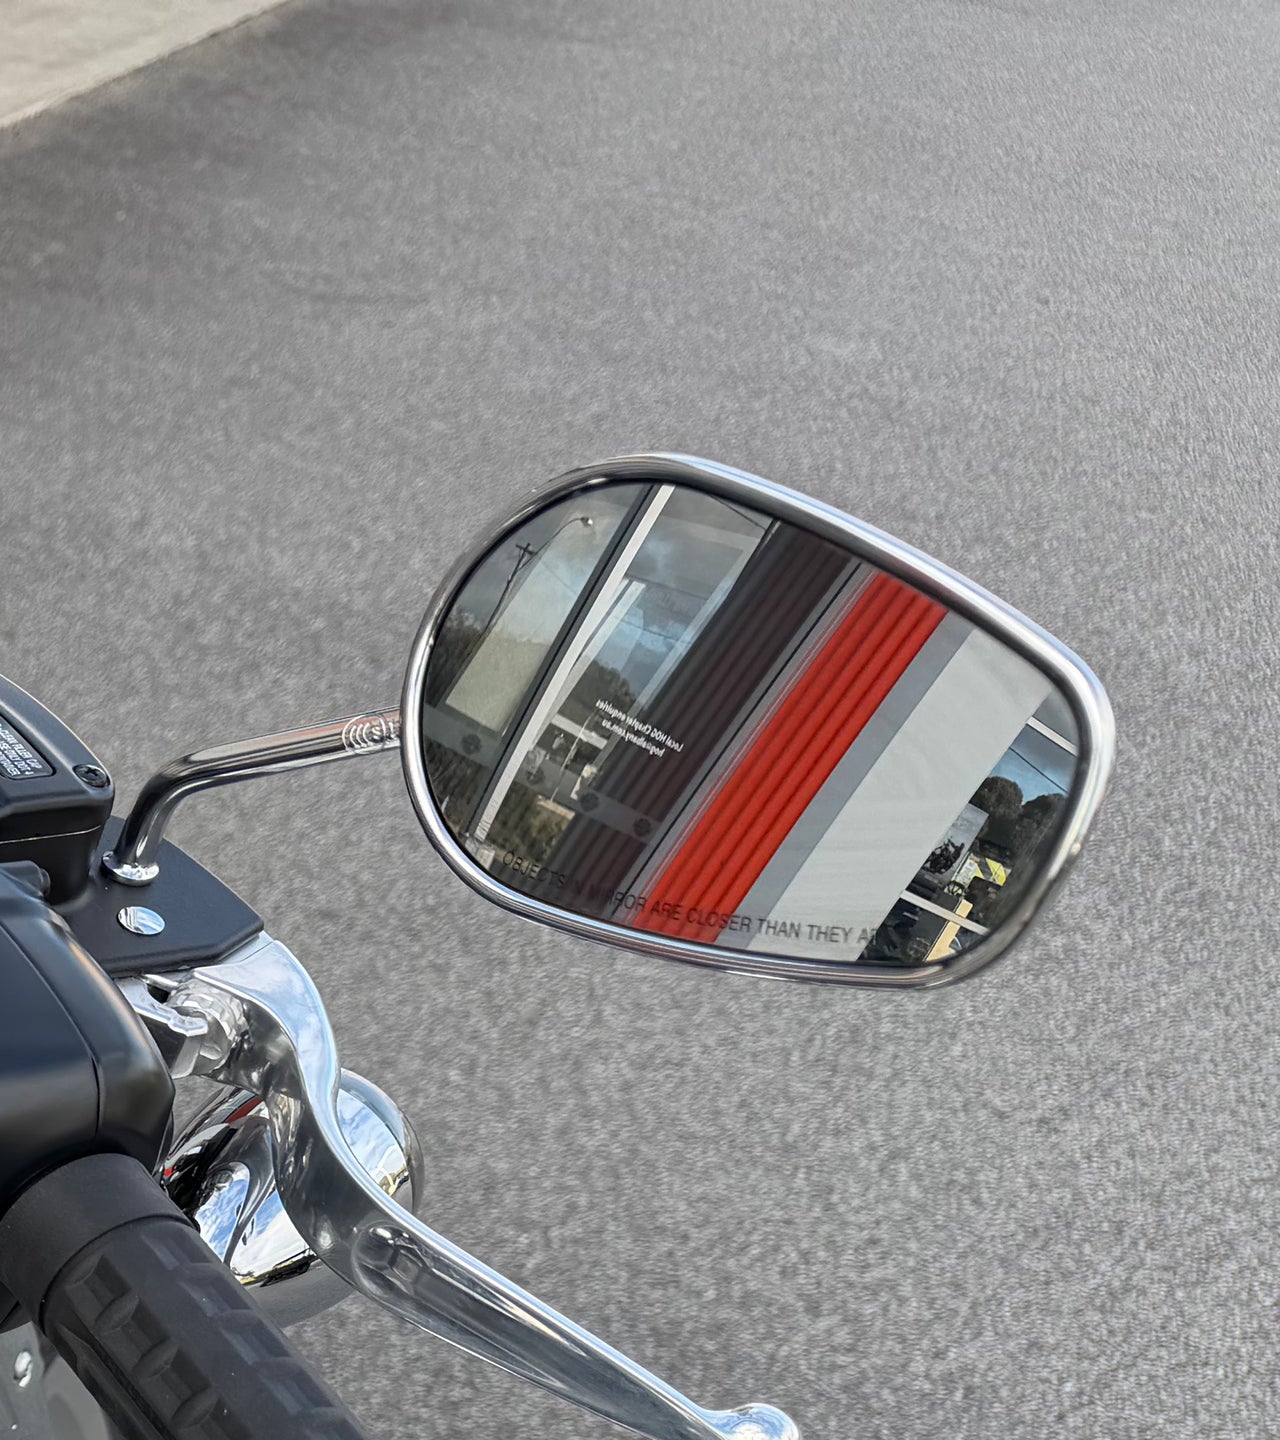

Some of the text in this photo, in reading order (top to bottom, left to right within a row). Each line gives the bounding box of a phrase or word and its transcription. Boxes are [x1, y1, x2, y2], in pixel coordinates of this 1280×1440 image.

[501, 850, 567, 889] OBJECTS
[650, 899, 683, 921] ARE
[686, 907, 752, 934] CLOSER
[756, 917, 802, 940] THAN
[807, 924, 854, 945] THEY
